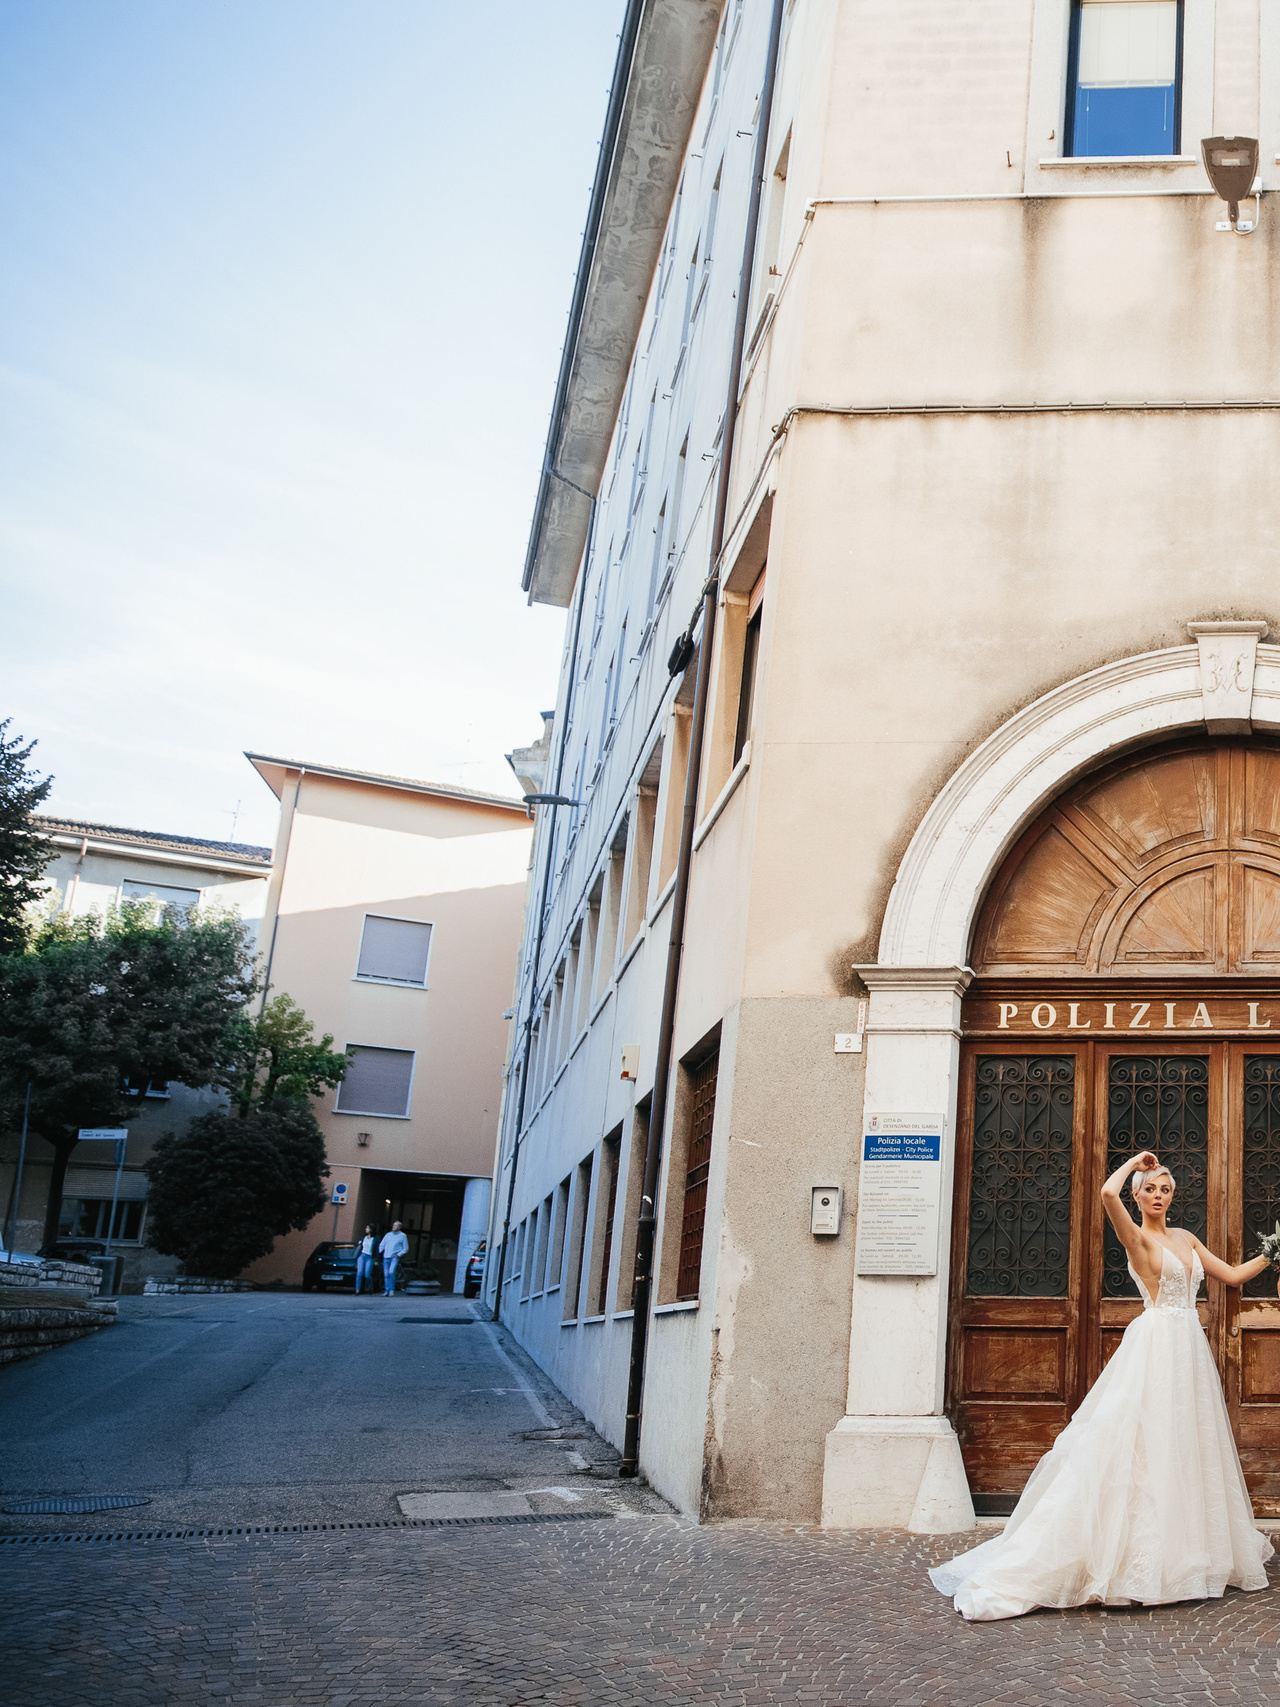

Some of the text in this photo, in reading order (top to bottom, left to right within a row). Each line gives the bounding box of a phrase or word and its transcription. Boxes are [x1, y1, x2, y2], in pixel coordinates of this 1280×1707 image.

[997, 1002, 1214, 1029] POLIZIA
[844, 1037, 852, 1048] 2
[877, 1137, 926, 1145] Polizia locale
